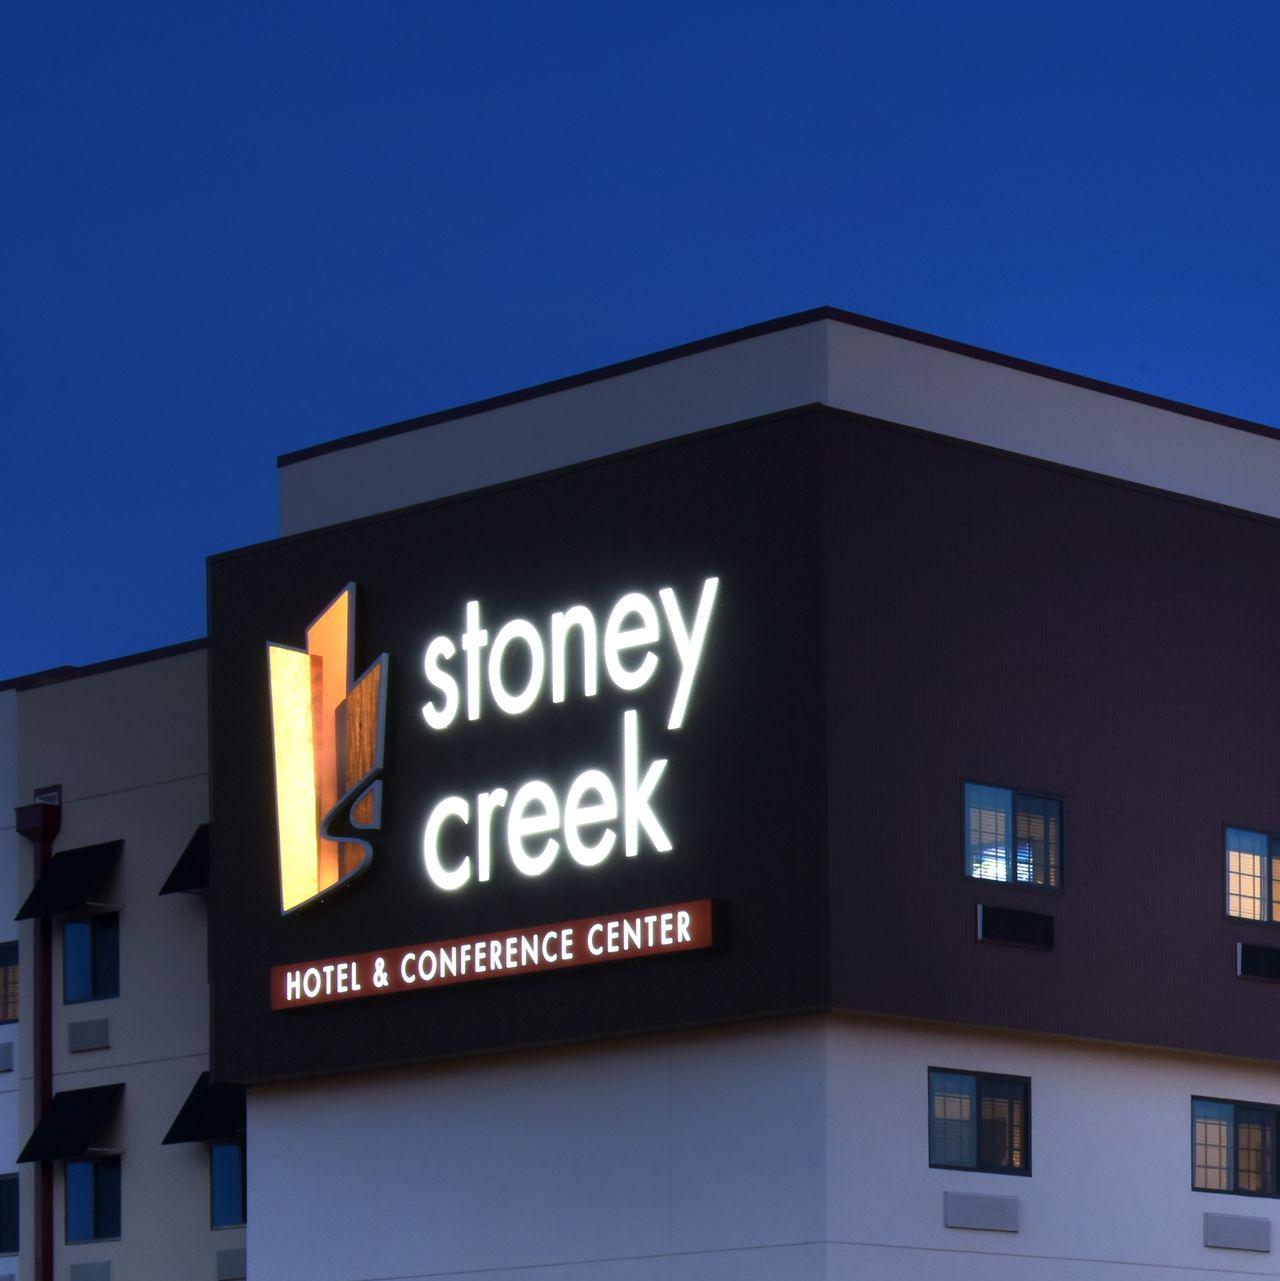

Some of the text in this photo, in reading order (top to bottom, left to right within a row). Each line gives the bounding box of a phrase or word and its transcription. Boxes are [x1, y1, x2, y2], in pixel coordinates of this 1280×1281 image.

[421, 576, 719, 730] stoney
[423, 709, 673, 891] creek
[286, 910, 692, 1001] HOTEL & CONFERENCE CENTER
